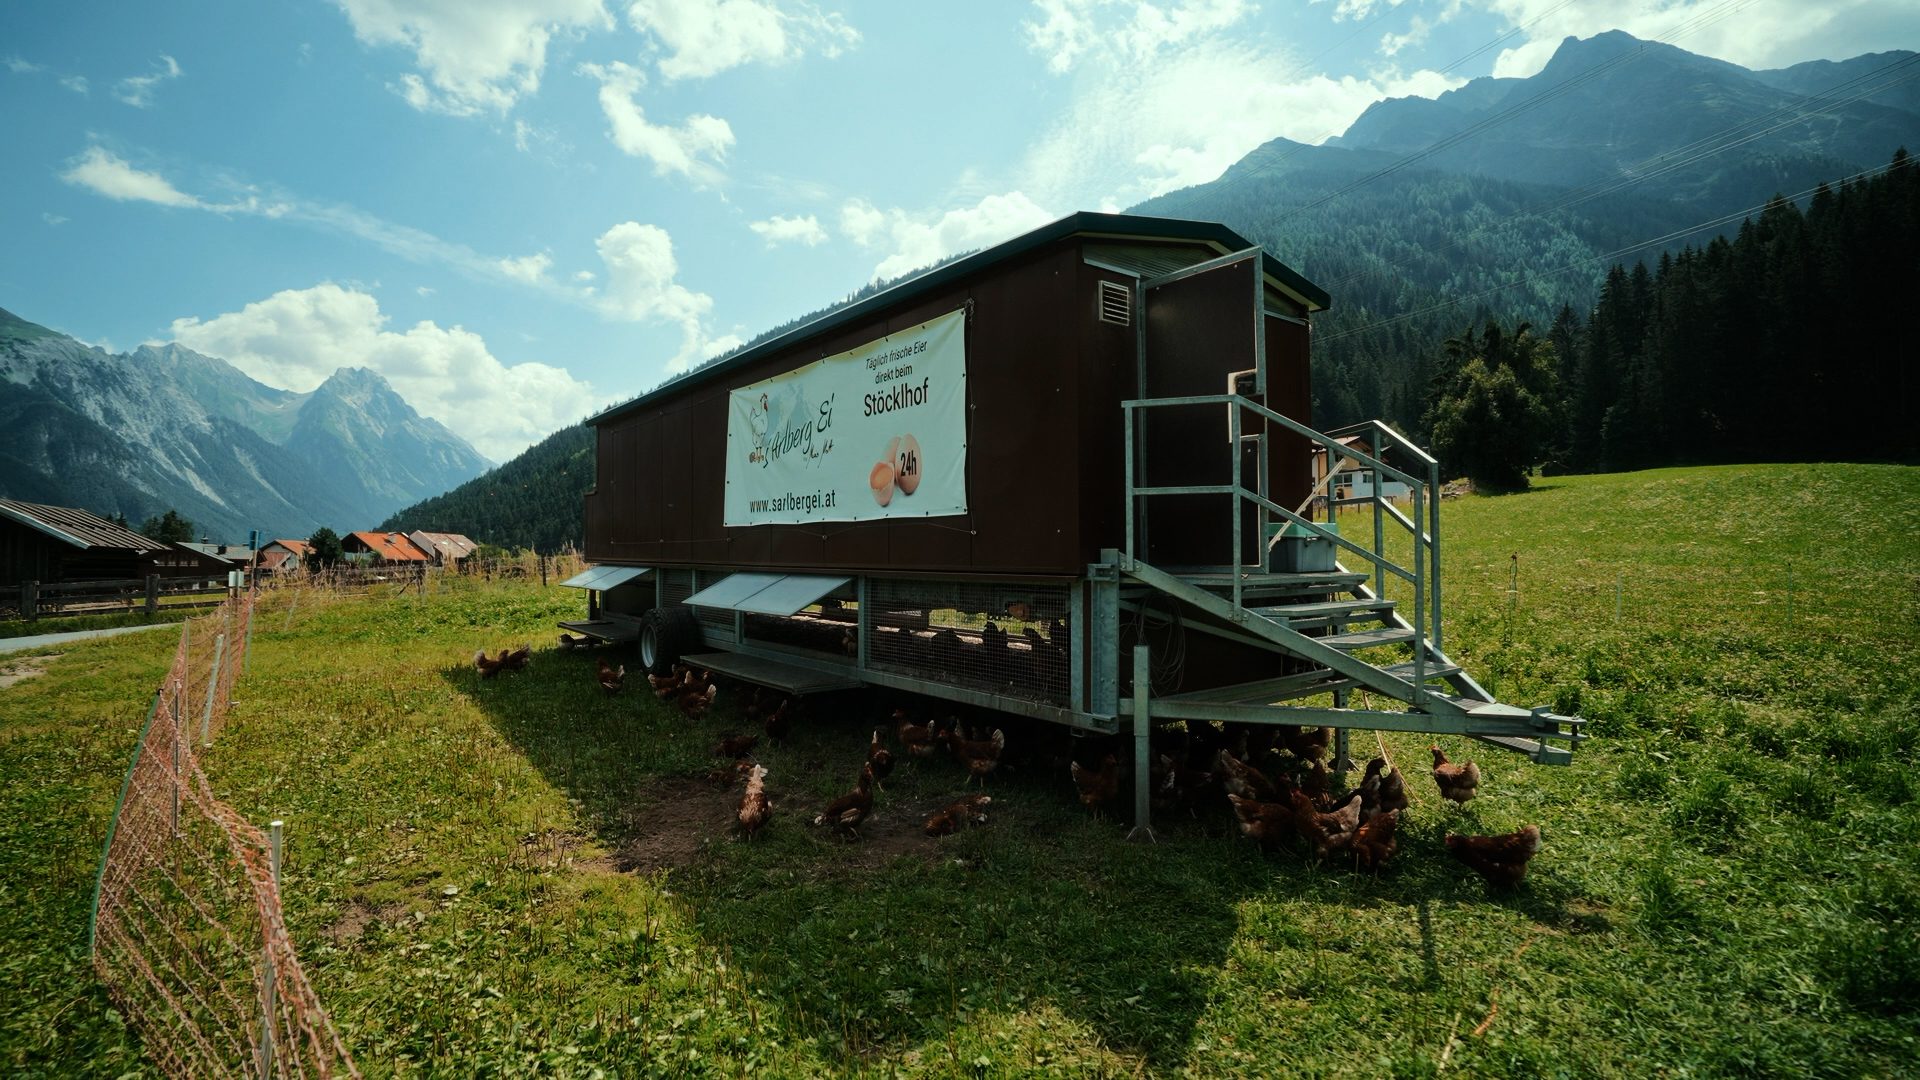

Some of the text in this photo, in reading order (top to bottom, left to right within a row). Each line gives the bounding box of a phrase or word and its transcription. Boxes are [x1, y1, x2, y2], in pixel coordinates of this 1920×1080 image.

[865, 340, 928, 371] Täglich frische Eier
[874, 364, 913, 384] direkt beim
[863, 376, 929, 417] Stöcklhof
[817, 392, 835, 433] Ei
[900, 449, 917, 477] 24h
[749, 489, 836, 514] www.sarlbergei.at
